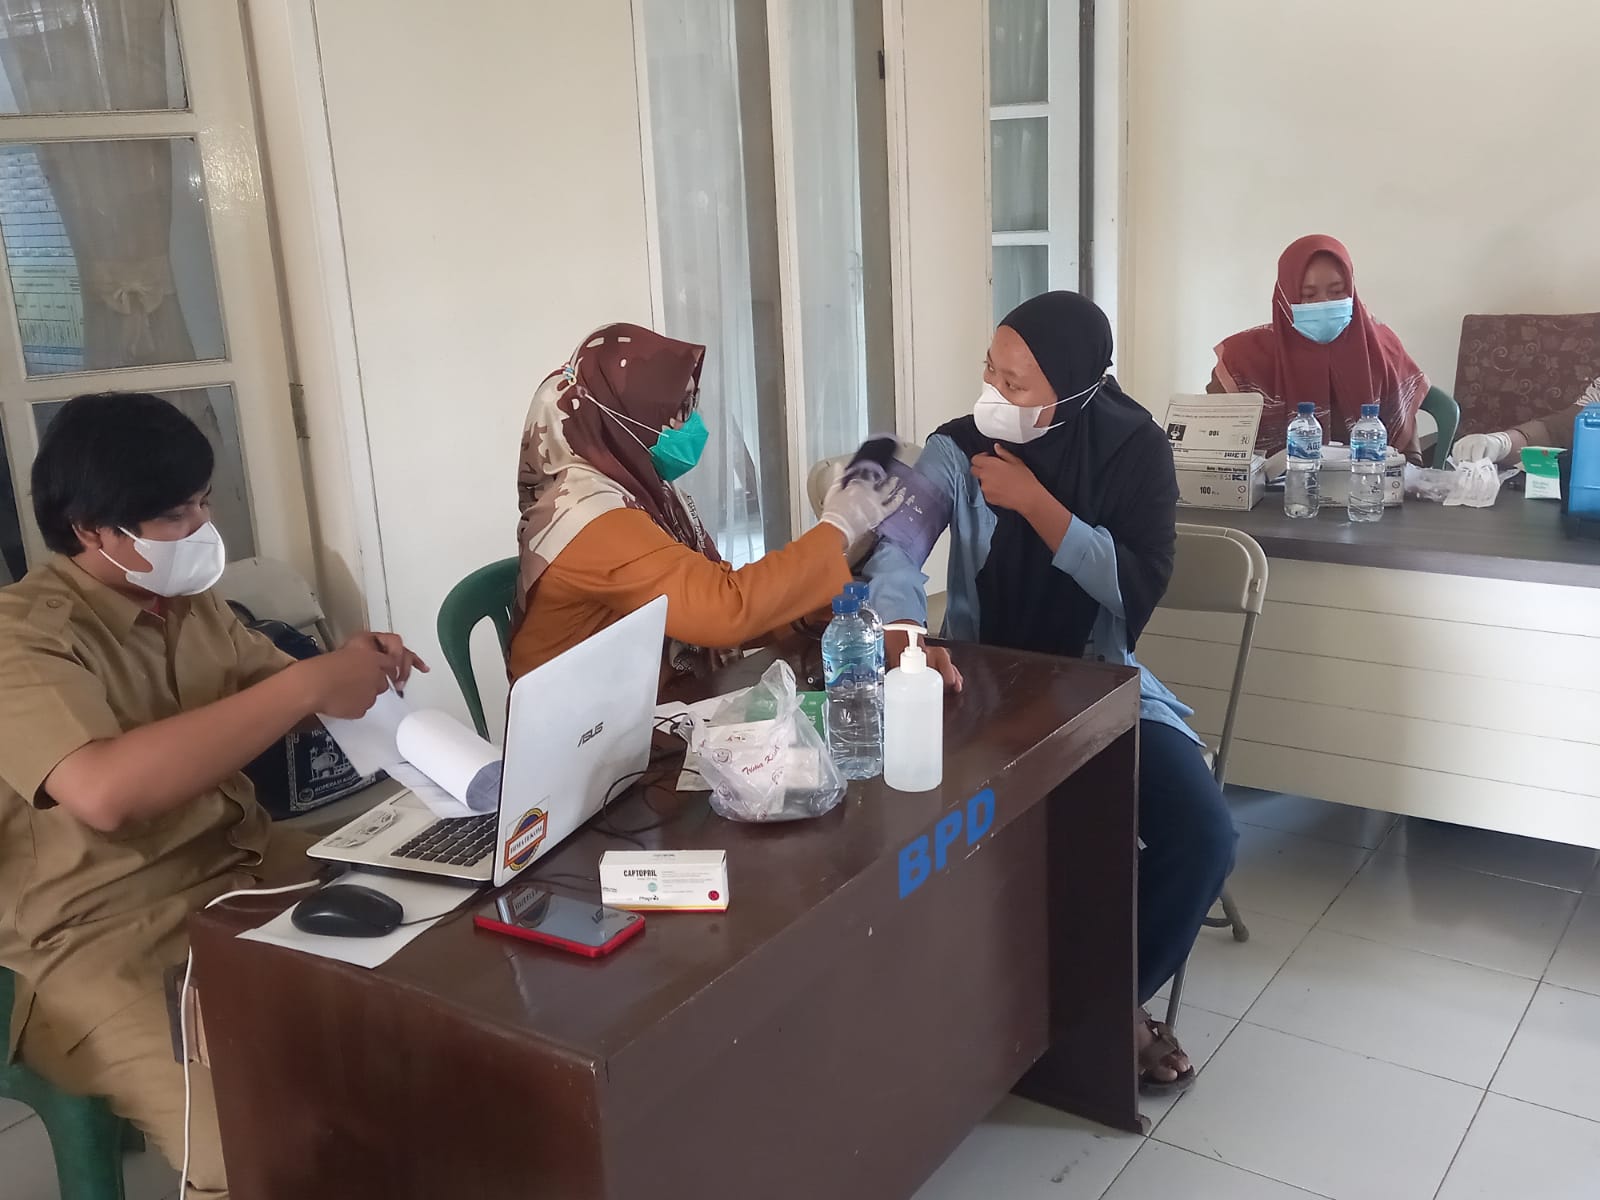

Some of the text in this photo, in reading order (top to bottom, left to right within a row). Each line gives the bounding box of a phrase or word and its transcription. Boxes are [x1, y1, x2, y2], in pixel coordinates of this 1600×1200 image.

[1200, 486, 1212, 495] 100
[577, 721, 604, 748] ASUS
[898, 788, 996, 901] BPD
[623, 869, 658, 877] CAPTOPRIL
